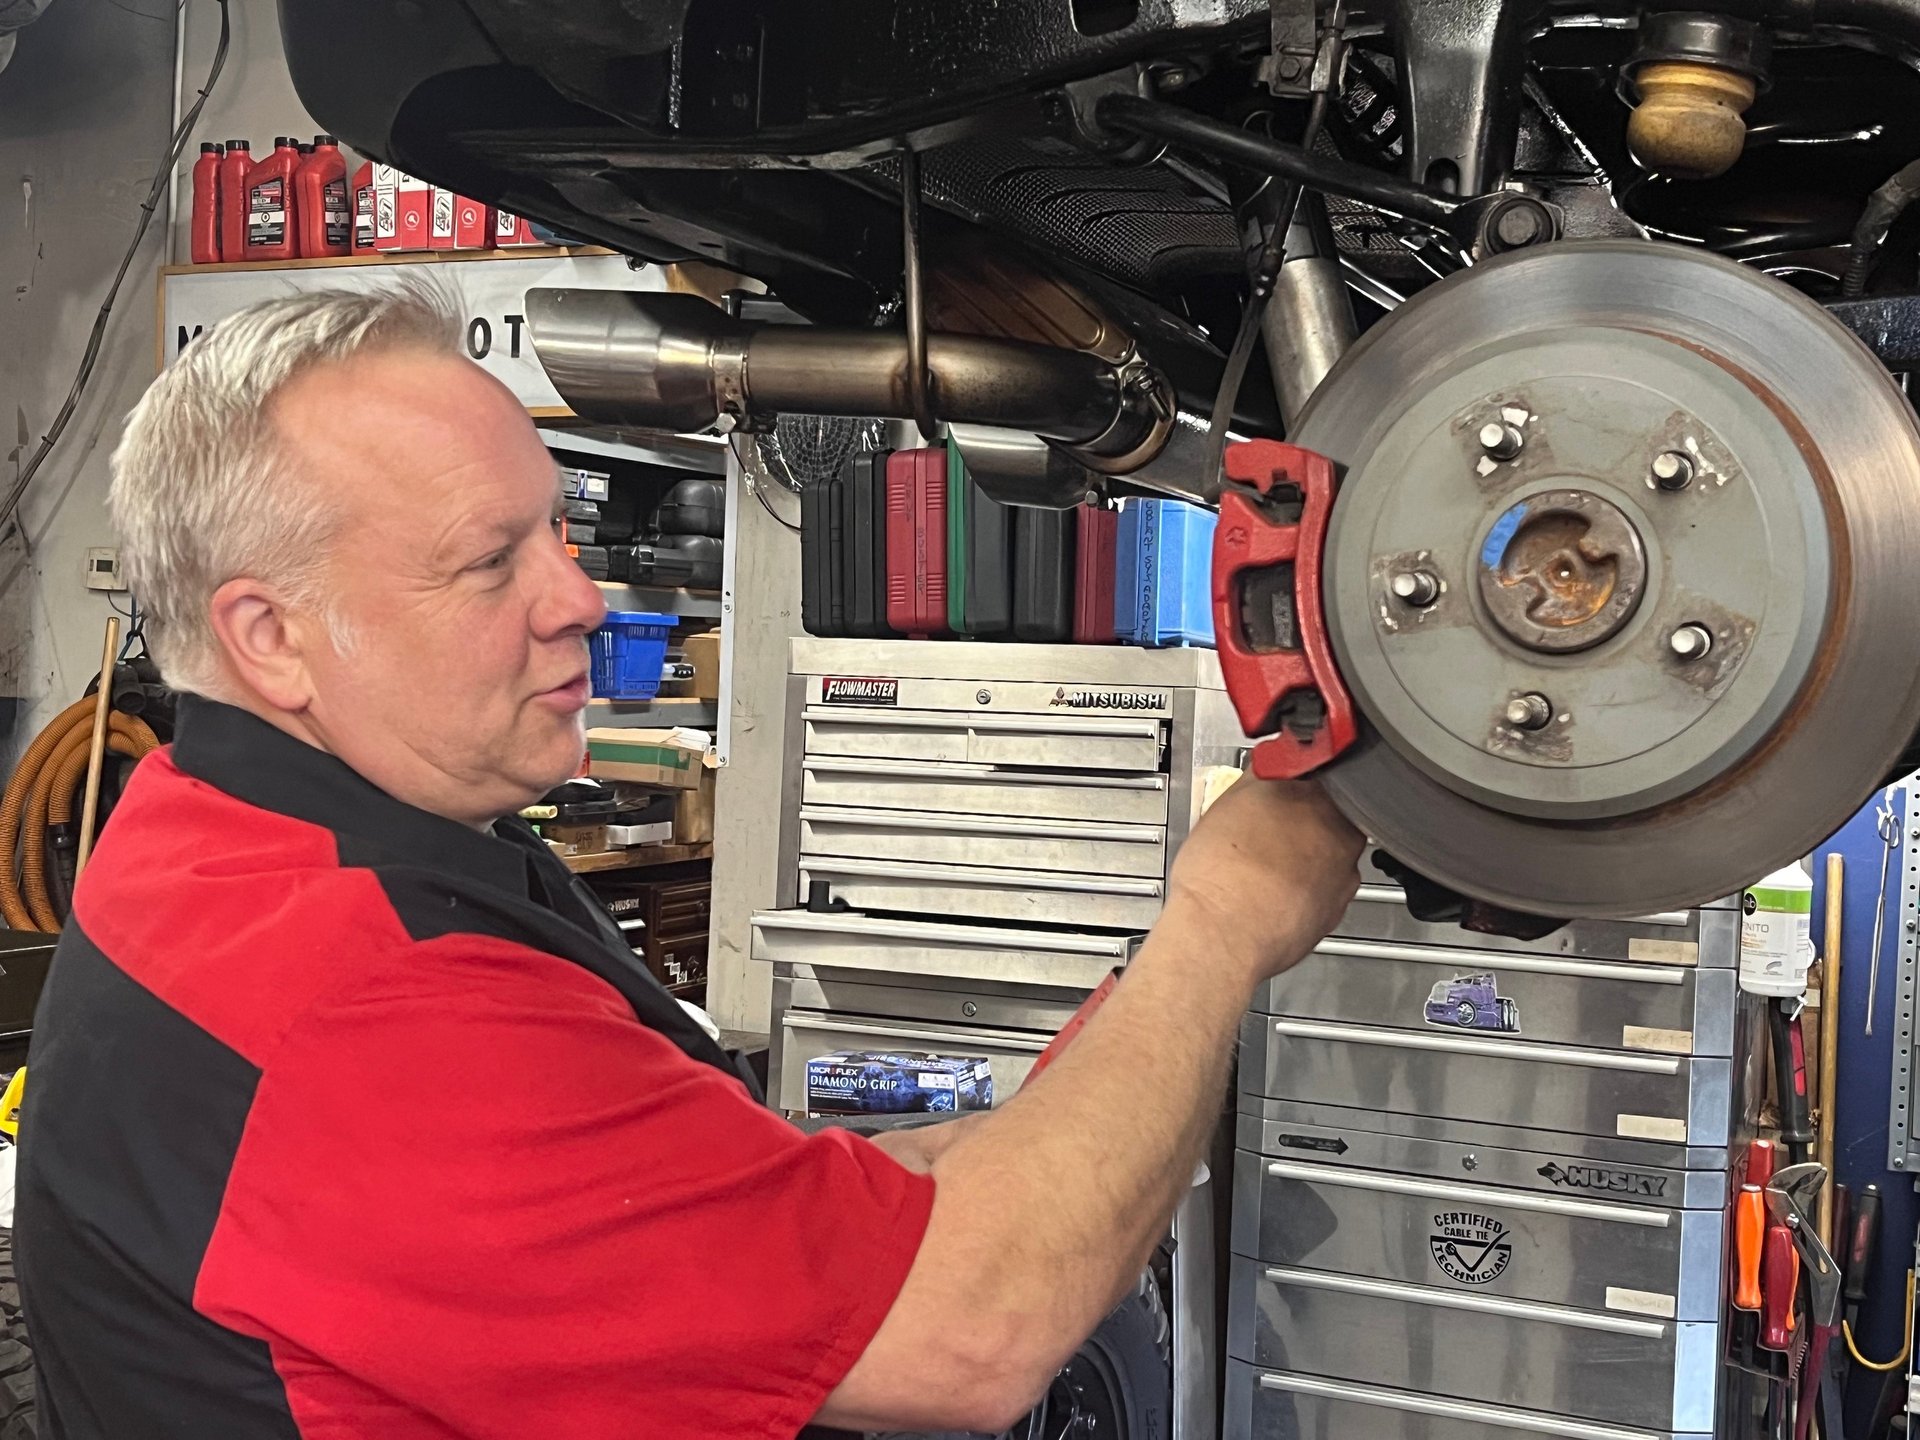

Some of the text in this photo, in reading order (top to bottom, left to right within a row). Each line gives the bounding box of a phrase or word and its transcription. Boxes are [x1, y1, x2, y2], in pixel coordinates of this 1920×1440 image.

[825, 680, 896, 700] FLOWMASTER
[1071, 692, 1167, 711] MITSUBISHI
[810, 1076, 897, 1091] DIAMOND GRIP
[1567, 1165, 1668, 1197] HUSKY
[1433, 1212, 1503, 1234] CERTIFIED
[1444, 1227, 1489, 1240] CABLE TIE
[1434, 1244, 1508, 1282] TECHNICIAN
